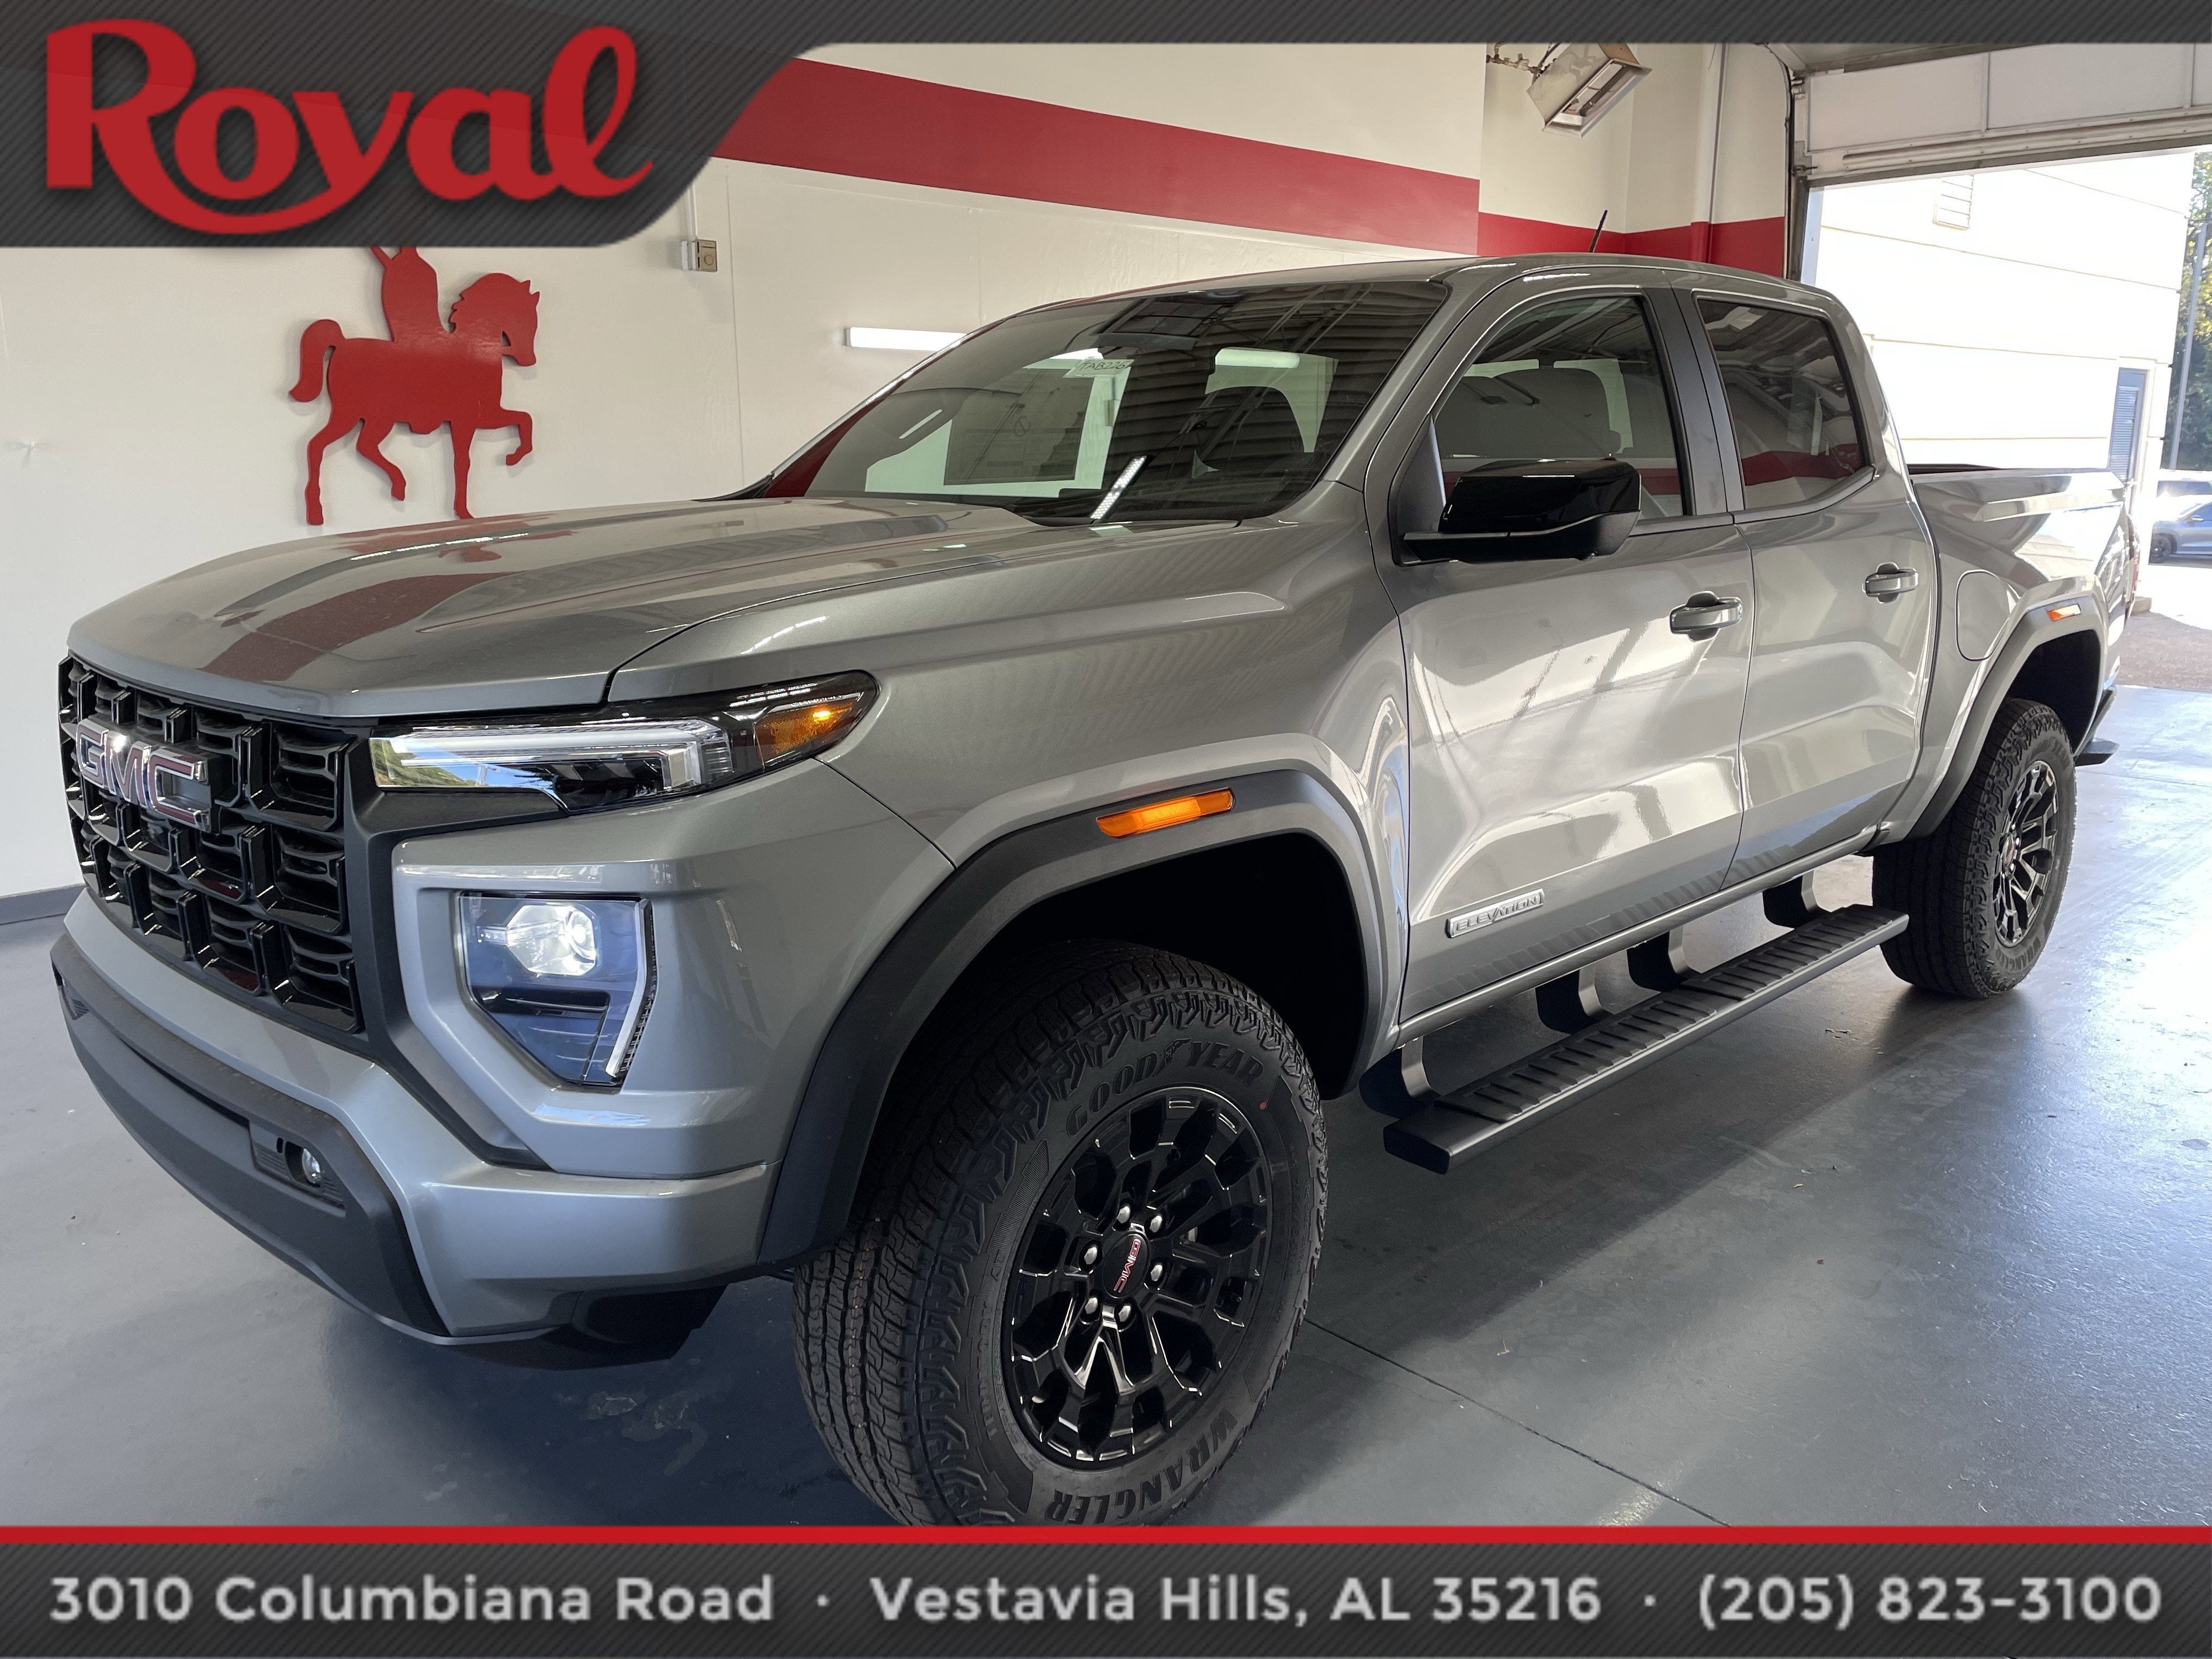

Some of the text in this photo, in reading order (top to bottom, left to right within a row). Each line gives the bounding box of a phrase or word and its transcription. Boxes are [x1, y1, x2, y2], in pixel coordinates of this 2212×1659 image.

[76, 718, 209, 831] GMC
[1455, 895, 1538, 932] ELEVATION
[1113, 1238, 1141, 1293] GMC
[1045, 1408, 1238, 1526] WRANGLER
